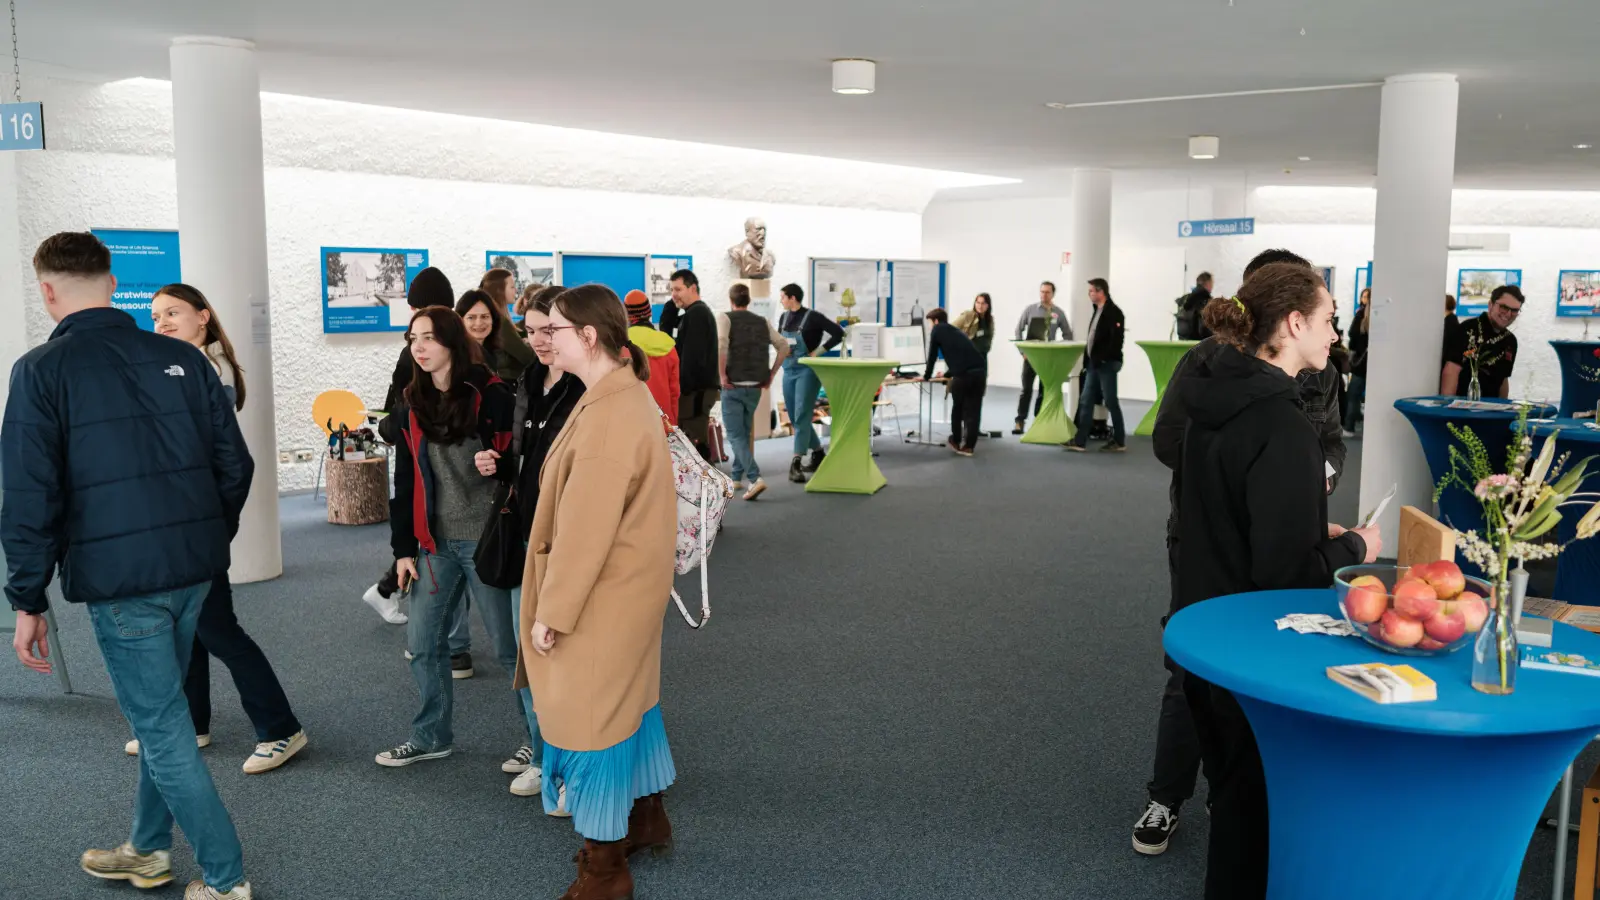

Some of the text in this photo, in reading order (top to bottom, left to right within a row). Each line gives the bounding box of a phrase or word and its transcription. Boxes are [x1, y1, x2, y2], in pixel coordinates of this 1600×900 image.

[10, 112, 34, 140] 16
[1203, 221, 1251, 233] Hörsaal 15
[112, 290, 155, 299] orstwiss
[111, 301, 152, 310] Ressourc
